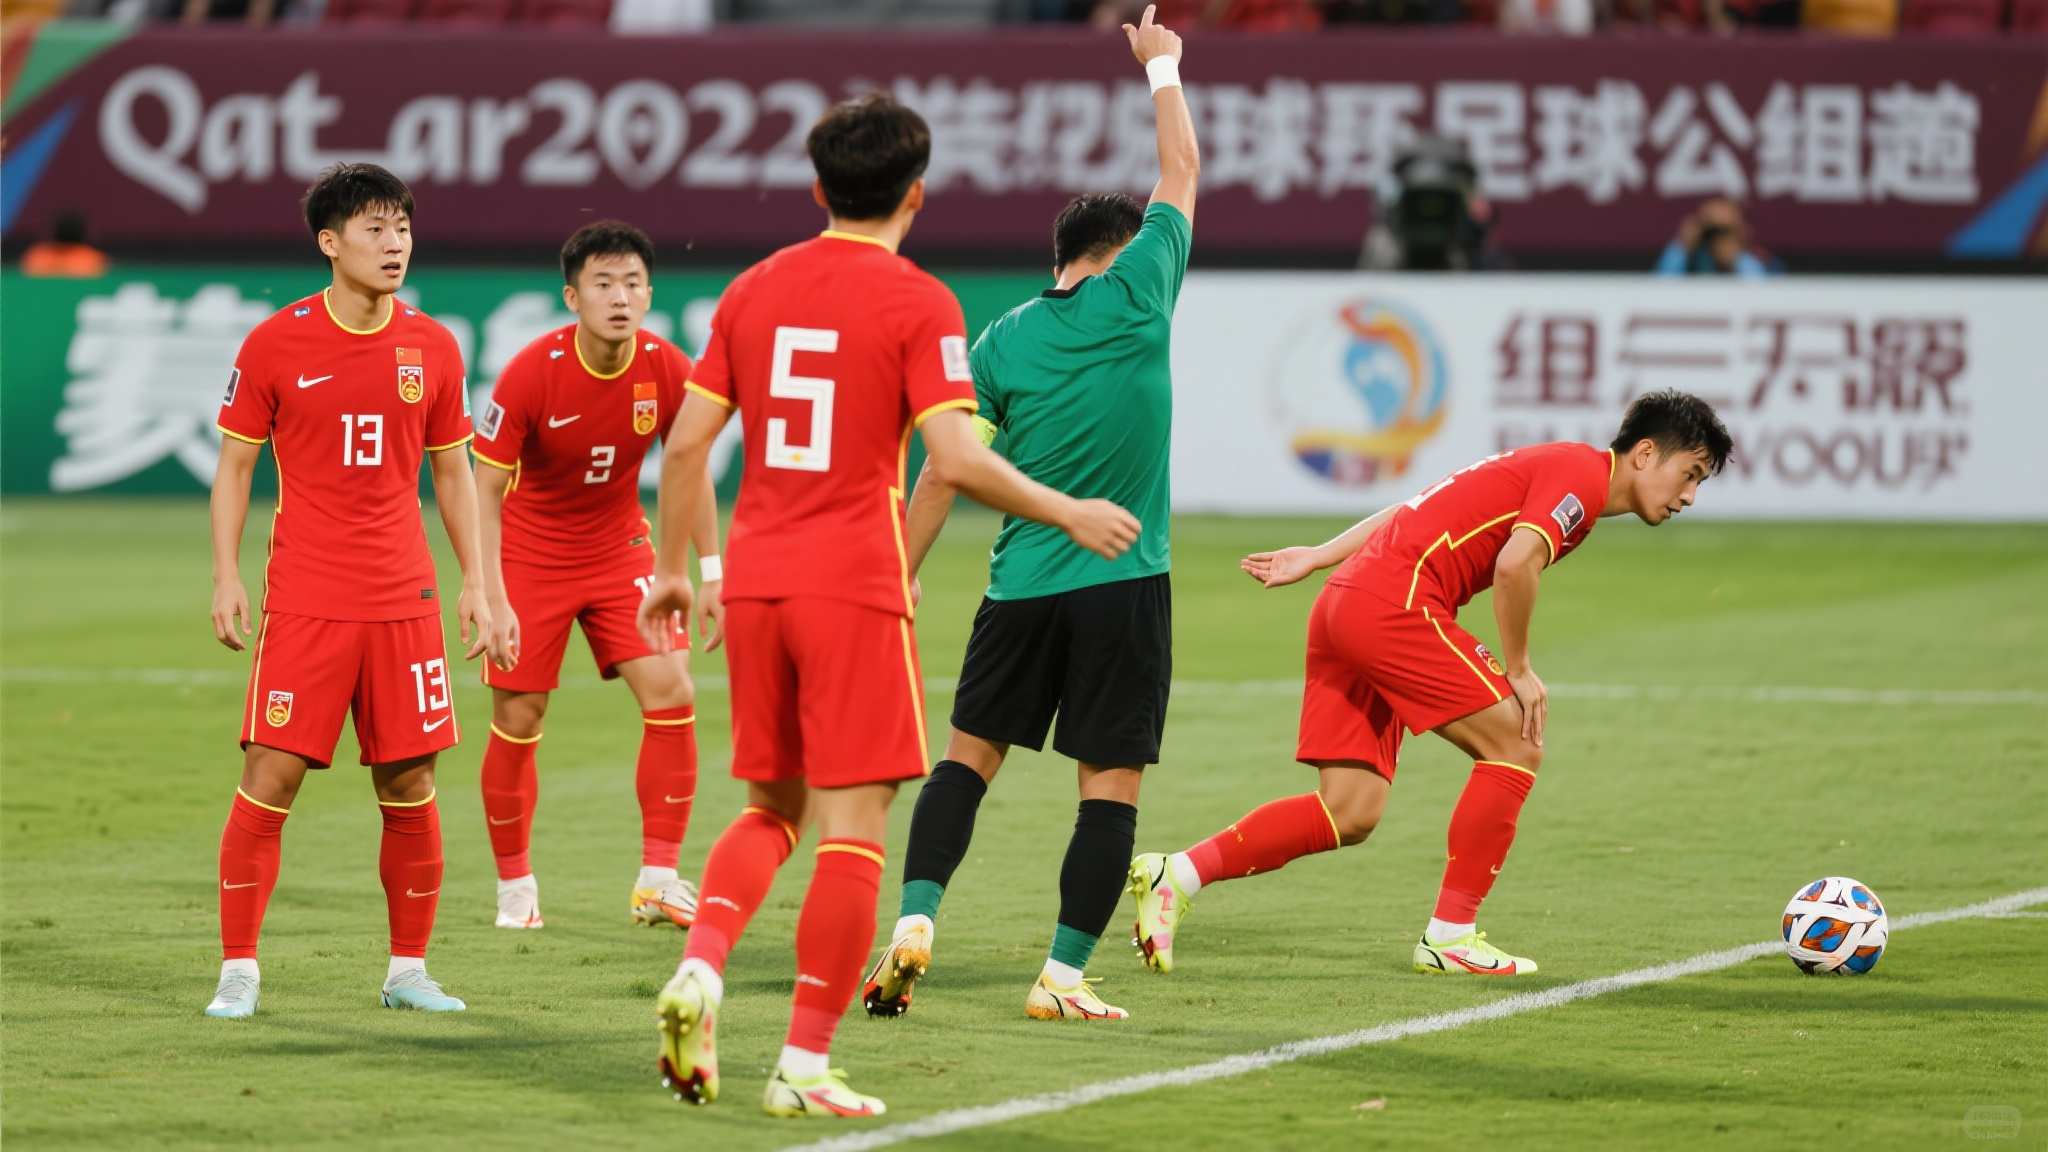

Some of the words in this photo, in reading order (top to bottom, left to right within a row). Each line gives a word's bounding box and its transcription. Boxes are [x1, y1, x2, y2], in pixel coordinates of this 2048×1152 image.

[765, 326, 839, 473] 5
[341, 414, 384, 466] 13
[411, 658, 449, 713] 13
